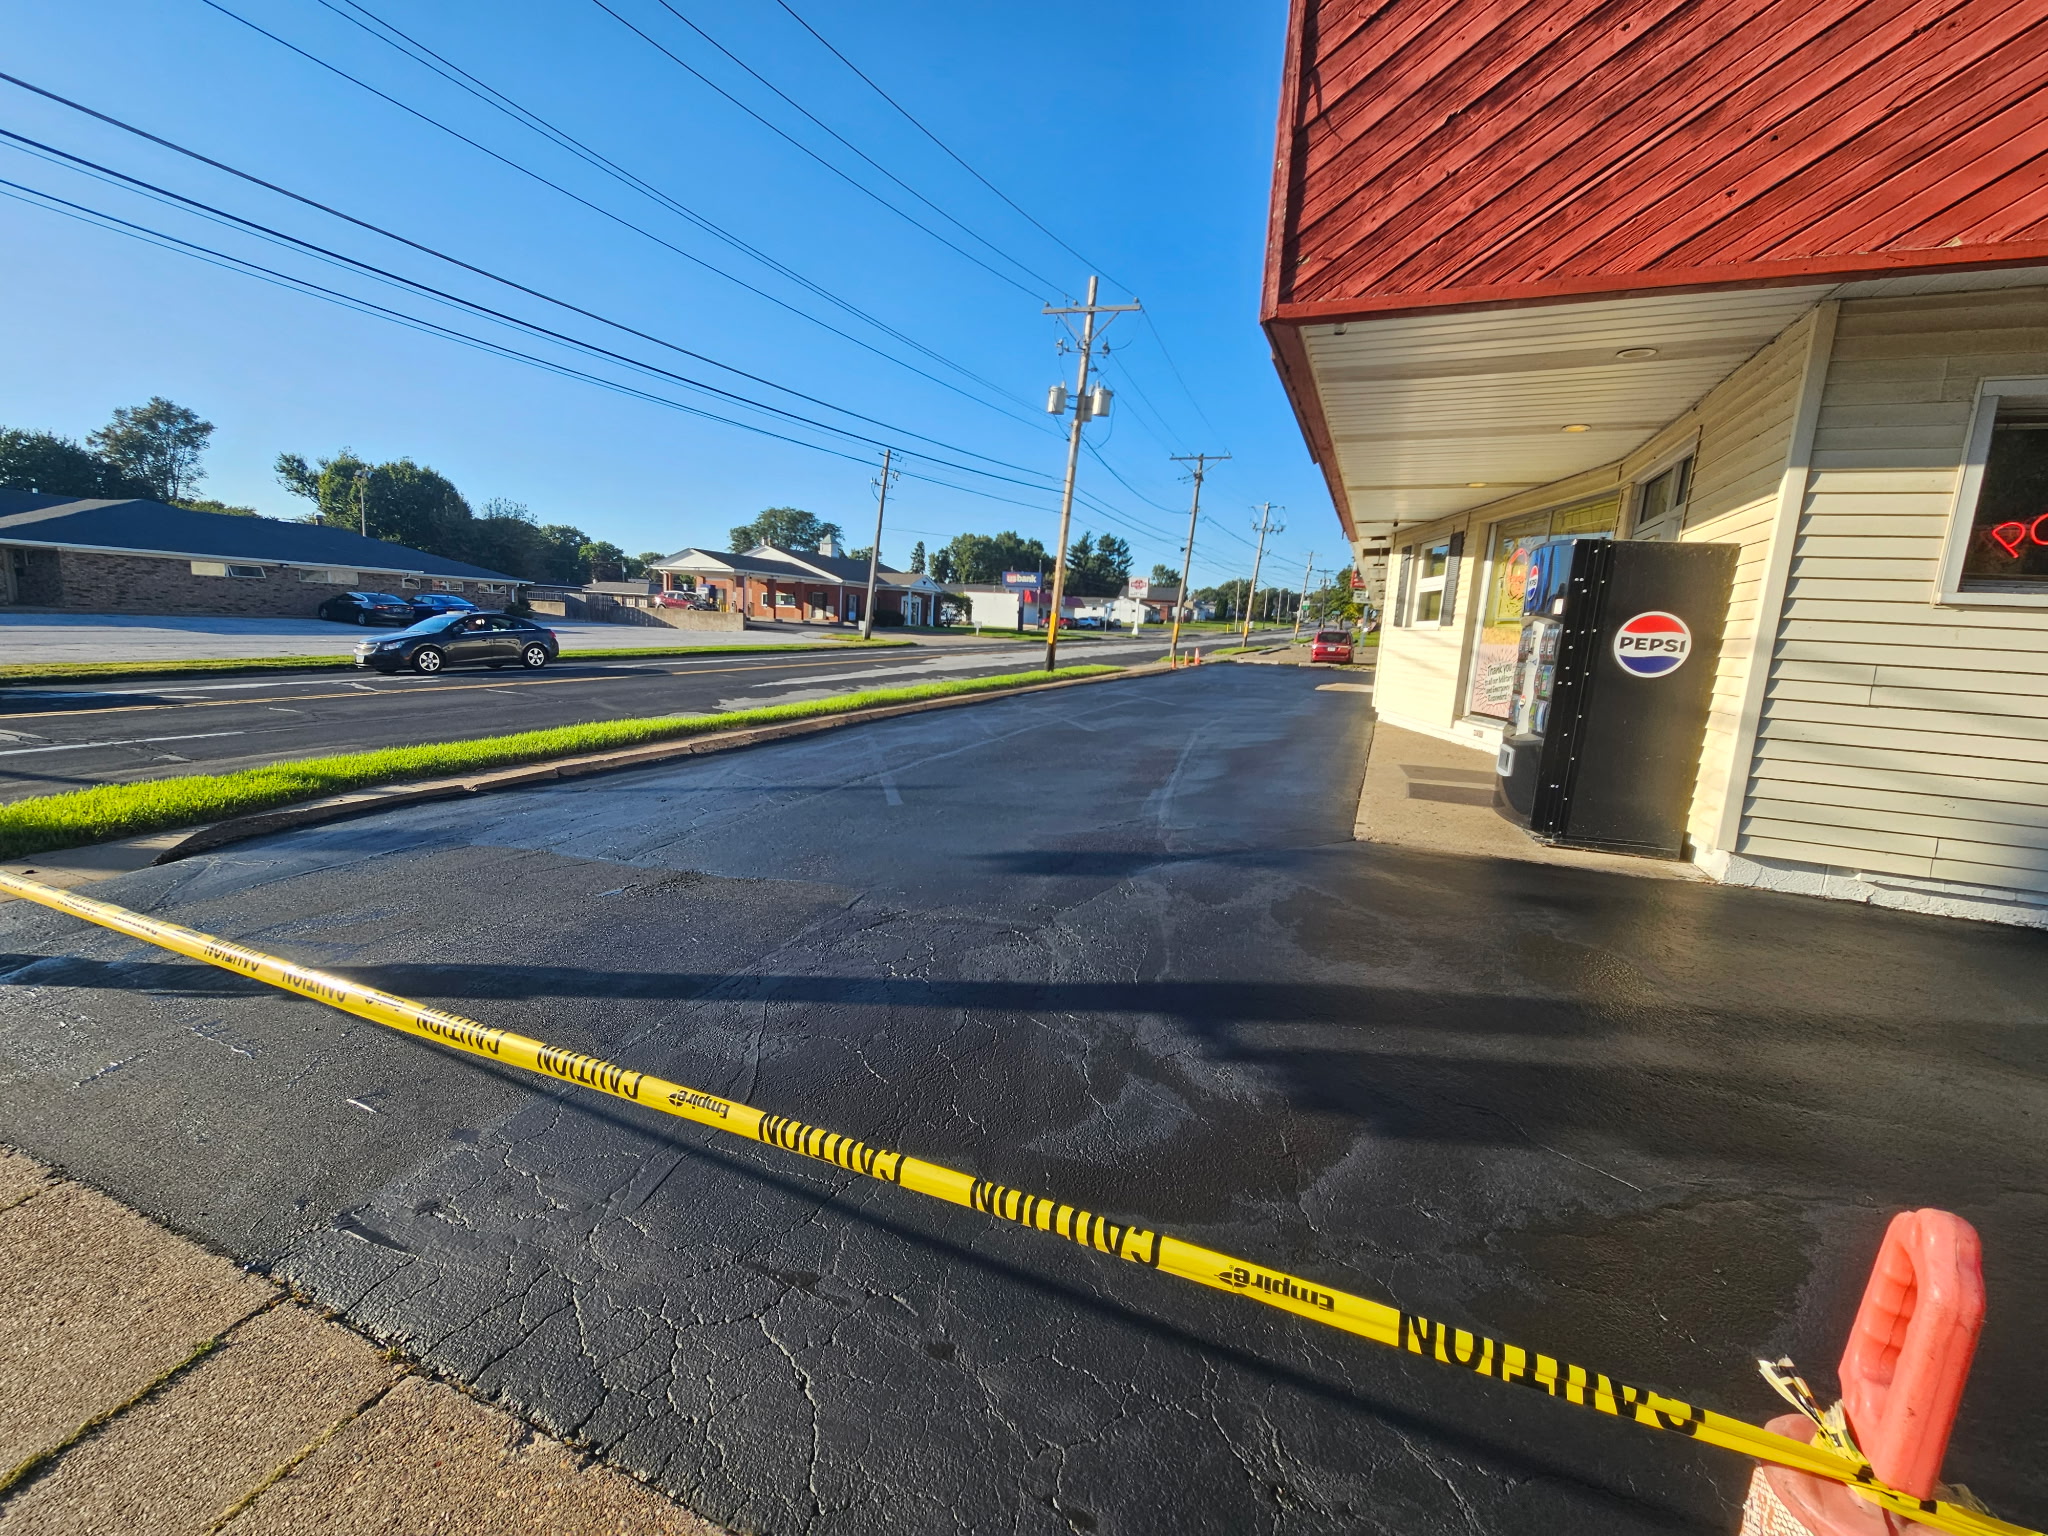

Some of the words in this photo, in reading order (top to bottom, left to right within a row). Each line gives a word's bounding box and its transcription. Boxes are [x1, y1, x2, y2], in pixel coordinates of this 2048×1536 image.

[1619, 636, 1687, 653] PEPSI
[416, 1007, 506, 1055] CAUTION
[537, 1045, 644, 1100] CAUTION
[676, 1089, 731, 1119] Empire
[758, 1113, 905, 1183] CAUTION
[970, 1178, 1161, 1269] CAUTION
[1232, 1266, 1335, 1312] Empire
[1399, 1311, 1706, 1436] CAUTION
